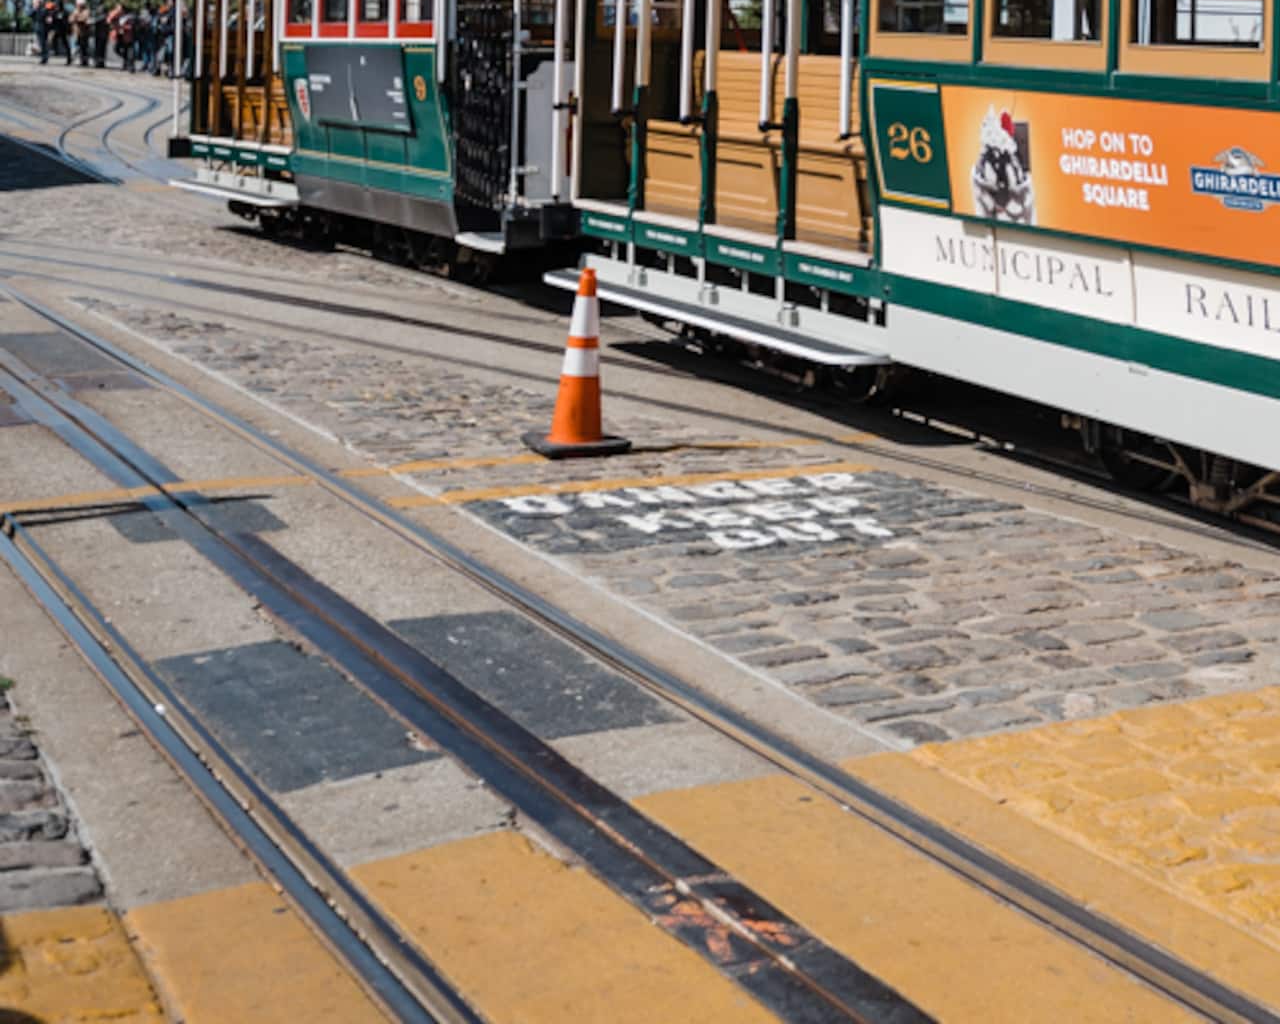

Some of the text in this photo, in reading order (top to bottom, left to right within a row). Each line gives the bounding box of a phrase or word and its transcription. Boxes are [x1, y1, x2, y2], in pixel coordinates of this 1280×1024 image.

[413, 75, 427, 102] 9
[887, 122, 933, 163] 26
[1061, 128, 1153, 156] HOP ON TO
[1059, 154, 1168, 186] GHIRARDELLI
[1082, 183, 1150, 211] SQUARE
[935, 235, 1113, 296] MUNICIPAL
[703, 516, 894, 550] OUT
